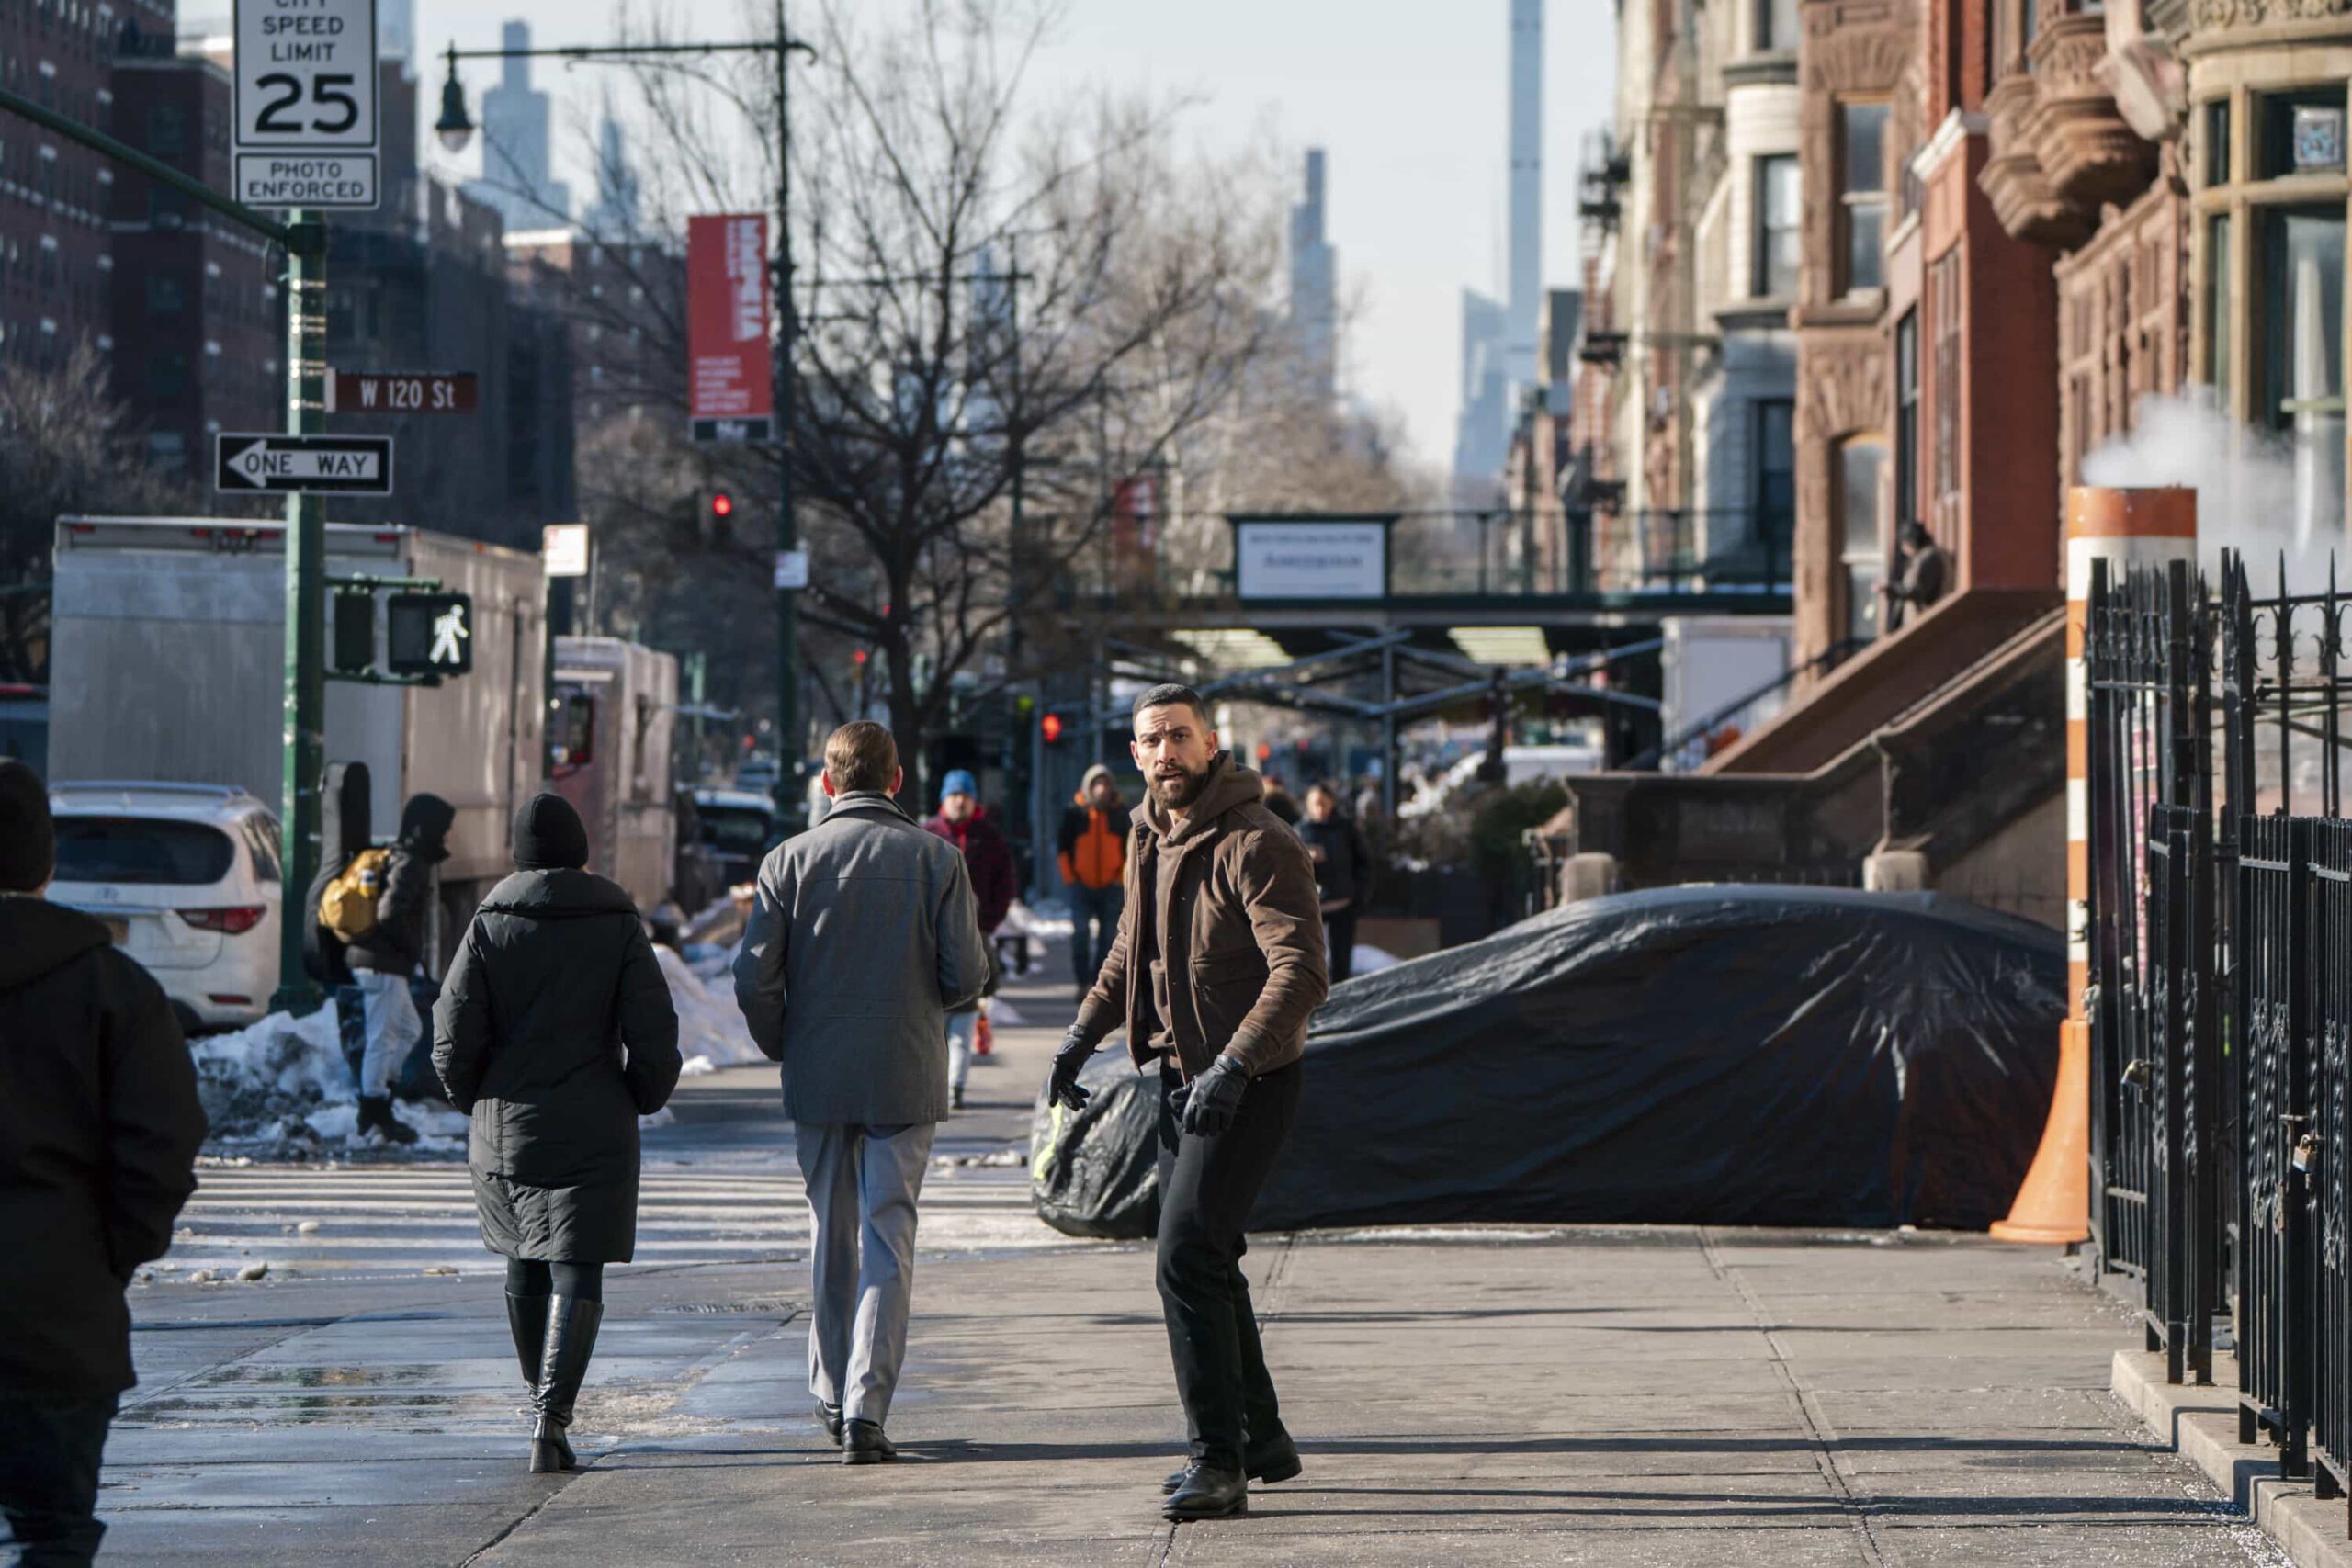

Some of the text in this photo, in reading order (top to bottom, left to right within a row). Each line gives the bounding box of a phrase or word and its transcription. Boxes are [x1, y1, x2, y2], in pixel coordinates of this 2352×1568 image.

[263, 16, 345, 35] SPEED
[271, 43, 335, 62] LIMIT
[255, 73, 359, 134] 25
[270, 162, 343, 178] PHOTO
[248, 181, 365, 197] ENFORCED
[360, 379, 455, 408] W 120 St
[244, 453, 368, 476] ONE WAY
